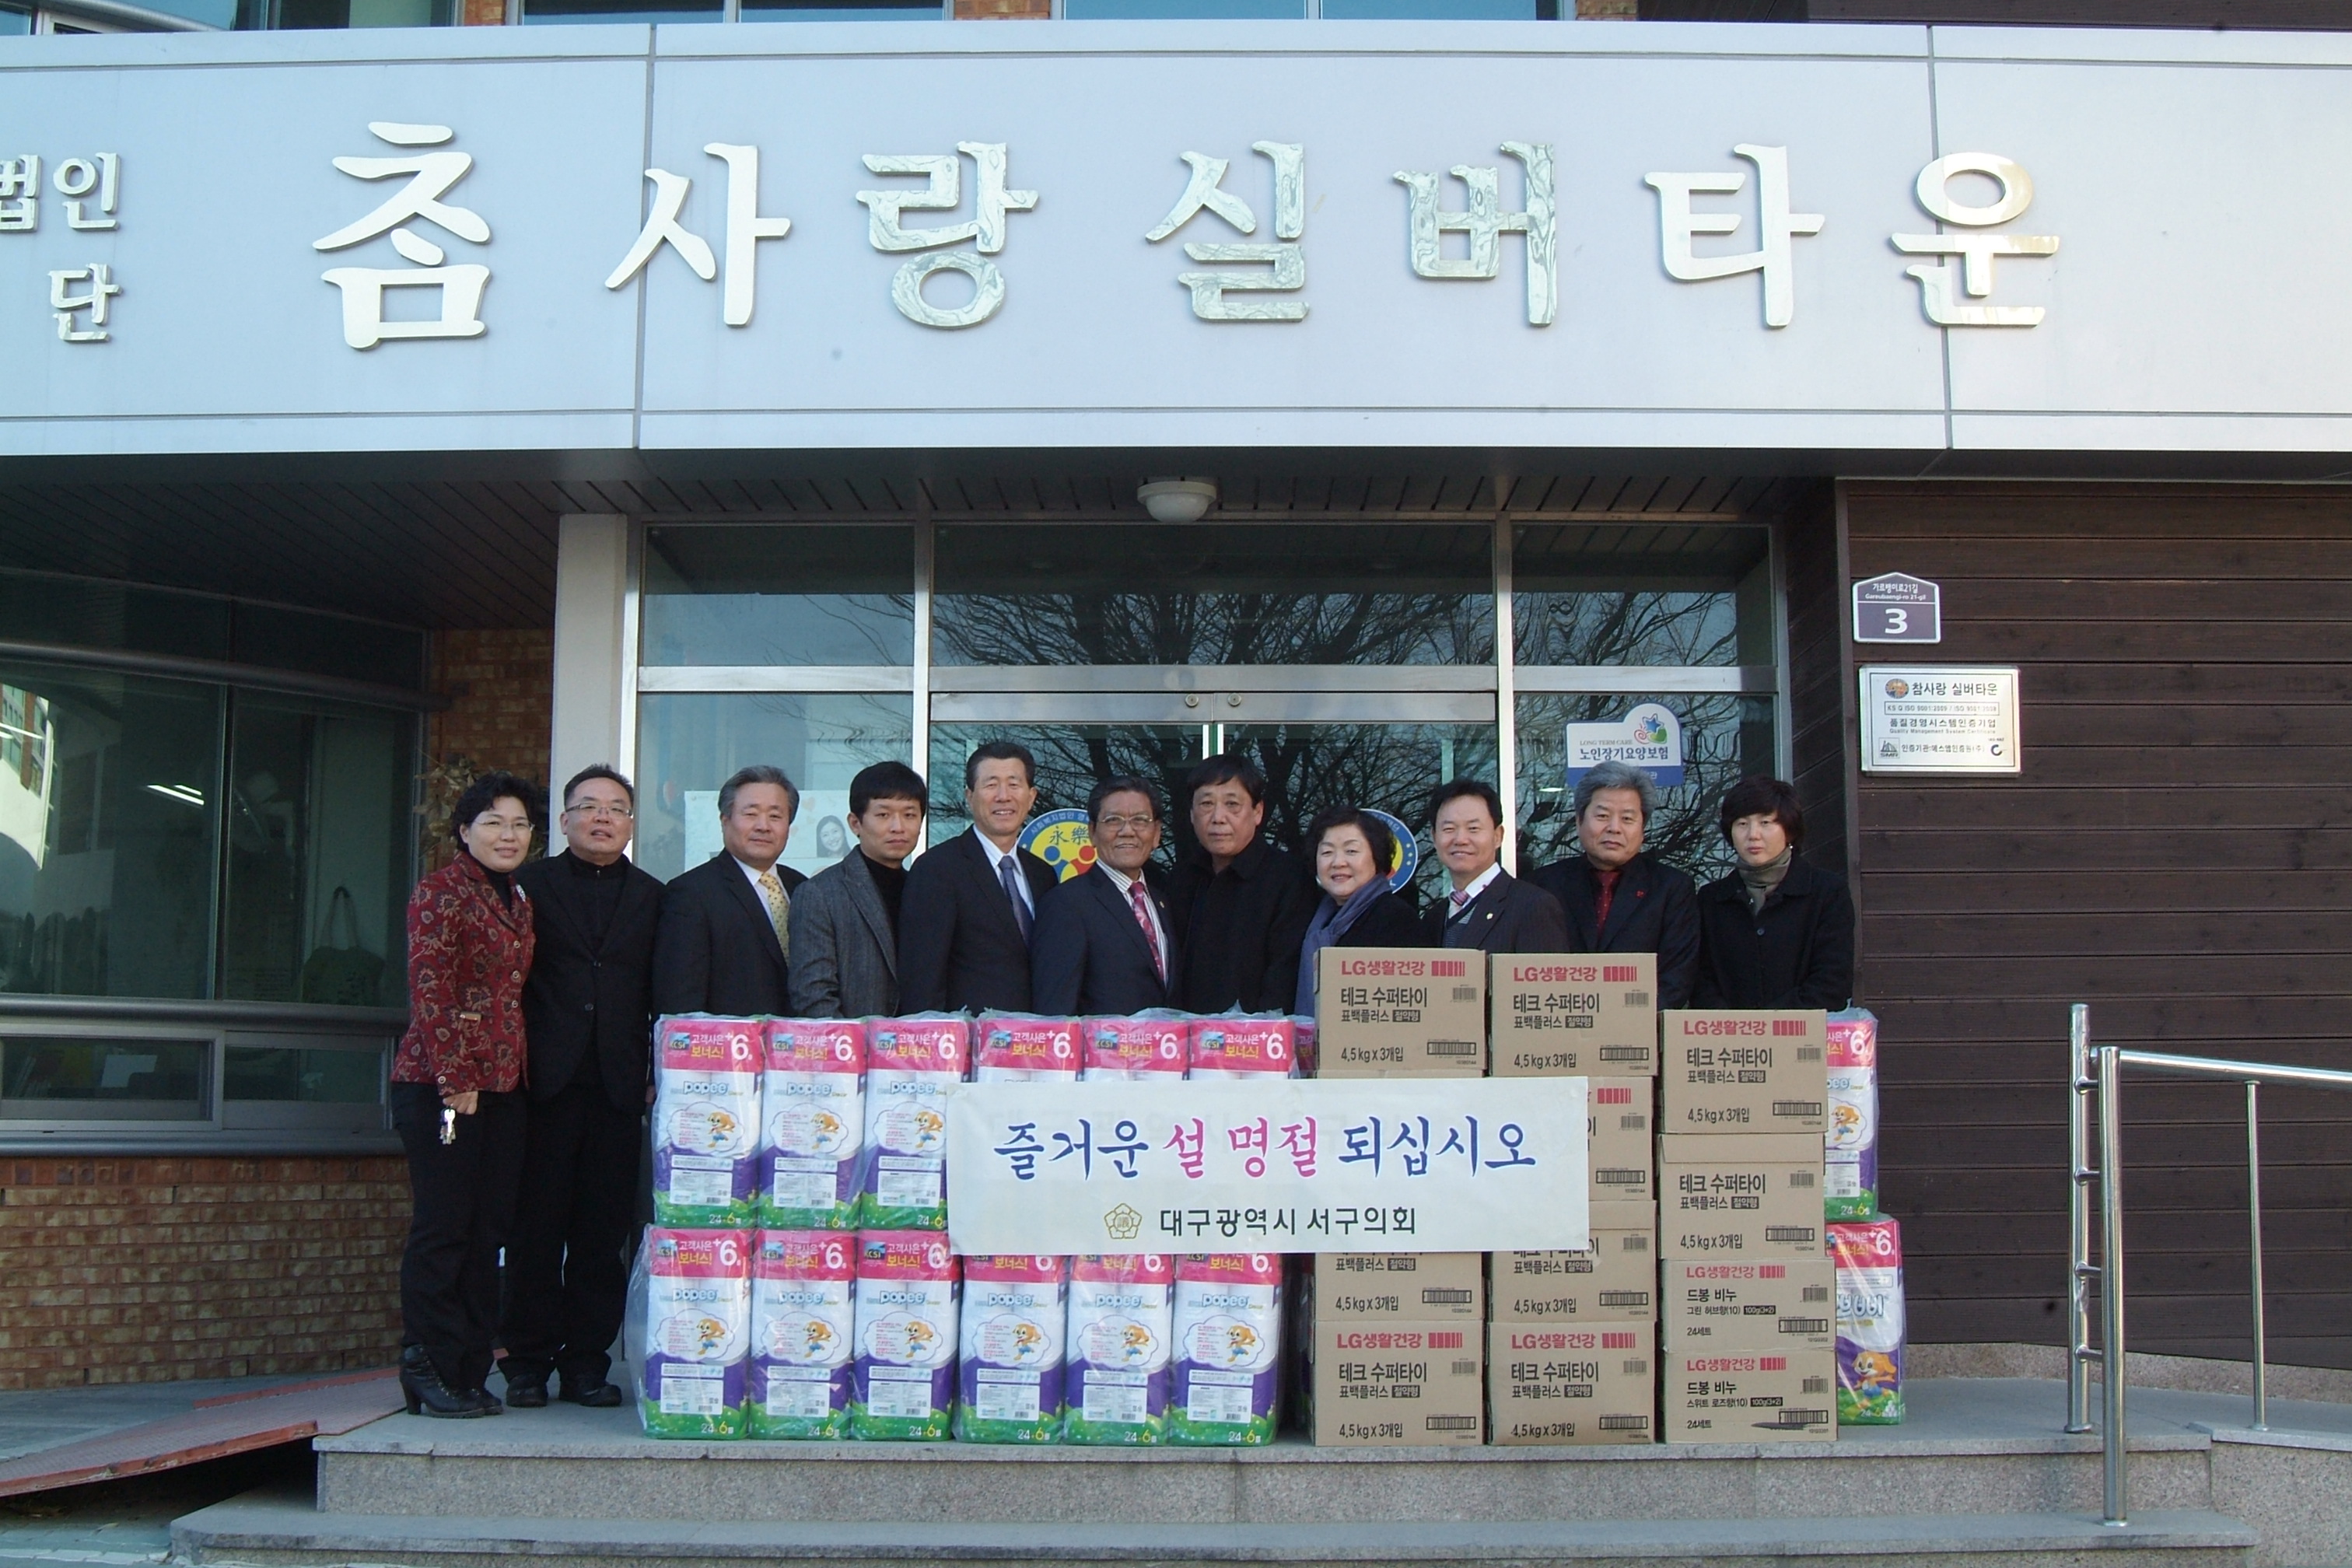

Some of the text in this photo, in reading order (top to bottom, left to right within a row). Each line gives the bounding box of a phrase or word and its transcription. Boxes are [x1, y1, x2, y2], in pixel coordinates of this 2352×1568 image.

[1885, 608, 1908, 634] 3
[1912, 682, 1997, 695] 참사랑 실버타운
[1580, 747, 1668, 761] 노인장기요양보험
[1341, 986, 1427, 1007] 테크 수퍼타이
[1513, 992, 1600, 1013] 테크 수퍼타이
[1341, 1010, 1390, 1023] 표백플러스
[1514, 1016, 1563, 1029] 표백플러스
[1686, 1047, 1773, 1068] 테크 수퍼타이
[1687, 1070, 1736, 1083] 표백플러스
[993, 1115, 1537, 1181] 즐거운 설 명절 되십시오
[1679, 1173, 1766, 1194] 테크 수퍼타이
[1680, 1196, 1728, 1210] 표백플러스
[1160, 1206, 1416, 1238] 대구광역시 서구의회
[1335, 1257, 1384, 1272] 표백플러스
[1514, 1260, 1563, 1275] 표백플러스
[1687, 1288, 1738, 1303] 드봉 비누
[1687, 1327, 1712, 1336] 24세트
[1339, 1361, 1428, 1383] 테크 수퍼타이
[1511, 1361, 1600, 1383] 테크 수퍼타이
[1339, 1384, 1388, 1399] 표백플러스
[1511, 1384, 1561, 1398] 표백플러스
[1687, 1381, 1738, 1395] 드봉 비누
[1687, 1419, 1713, 1430] 24세트
